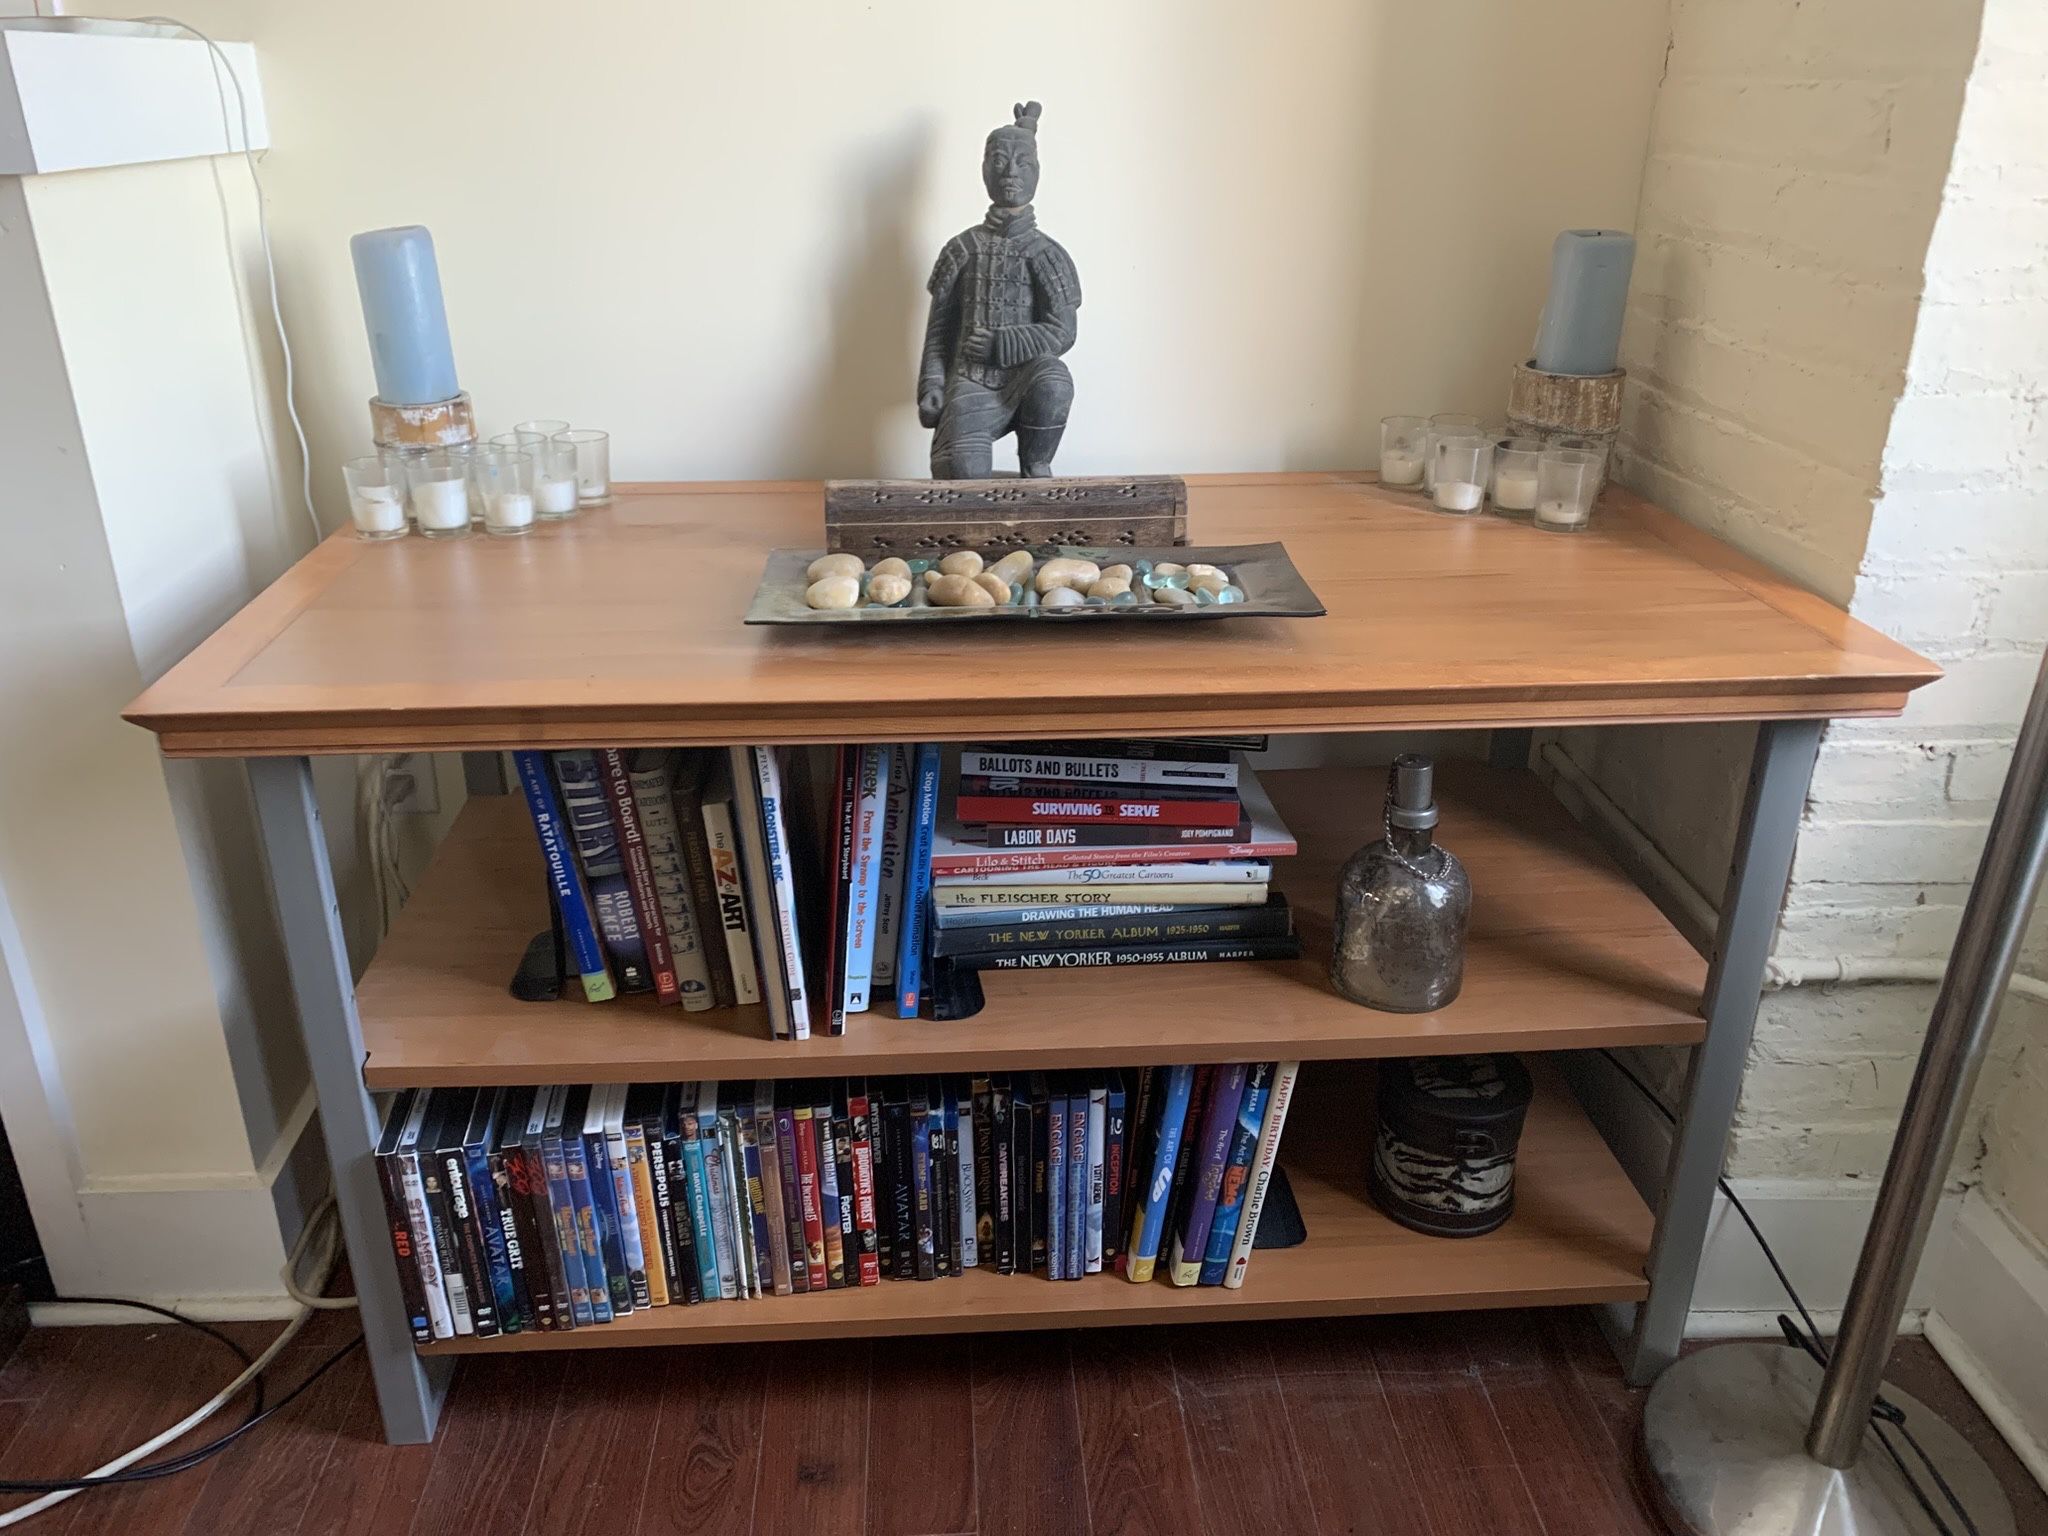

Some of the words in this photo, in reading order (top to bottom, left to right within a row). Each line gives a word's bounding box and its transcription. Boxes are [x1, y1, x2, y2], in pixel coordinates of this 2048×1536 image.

[524, 758, 536, 775] THE
[761, 755, 770, 784] PIXAR
[979, 757, 1032, 773] BALLOTS
[1035, 763, 1061, 775] AND
[1065, 763, 1119, 778] BULLETS
[529, 779, 541, 795] ART
[615, 780, 627, 795] to
[922, 771, 935, 792] Stop
[534, 798, 545, 810] OF
[556, 759, 623, 869] STORY
[844, 801, 852, 812] The
[921, 793, 932, 825] Motion
[1032, 802, 1102, 817] SURVIVING
[1119, 804, 1160, 818] SERVE
[619, 797, 640, 843] Board!
[862, 810, 874, 834] From
[715, 832, 725, 848] the
[843, 835, 851, 845] the
[882, 784, 907, 879] Animation
[920, 826, 929, 847] Craft
[1005, 830, 1041, 845] LABOR
[1047, 829, 1076, 844] DAYS
[1181, 829, 1194, 838] JOEY
[538, 813, 571, 897] RATATOUILLE
[861, 837, 873, 851] the
[1228, 845, 1254, 855] Disney
[841, 847, 850, 880] Storyboard
[916, 848, 928, 870] Skills
[976, 857, 999, 867] Lilo
[1012, 854, 1045, 865] Stitch
[1063, 853, 1091, 861] Collected
[1093, 852, 1115, 860] Stories
[1116, 852, 1131, 861] from
[1143, 851, 1162, 859] Film's
[641, 870, 650, 886] Story
[772, 864, 784, 885] INC.
[858, 855, 870, 886] Swamp
[916, 872, 926, 884] for
[1068, 871, 1083, 879] The
[1082, 870, 1101, 883] 50
[1101, 871, 1135, 879] Greatest
[1139, 871, 1174, 879] Cartoons
[724, 884, 733, 893] of
[859, 889, 868, 898] to
[956, 895, 975, 903] the
[981, 894, 1059, 903] FLEISCHER
[1065, 894, 1111, 903] STORY
[640, 900, 648, 911] and
[857, 902, 867, 916] the
[881, 893, 892, 916] Jeffrey
[913, 886, 924, 914] Model
[596, 894, 622, 941] McKEE
[614, 891, 639, 940] ROBERT
[721, 893, 746, 933] ART
[1022, 909, 1075, 921] DRAWING
[1078, 908, 1097, 918] THE
[1101, 905, 1140, 915] HUMAN
[1145, 905, 1174, 913] HEAD
[781, 910, 794, 950] ESSENTIAL
[854, 919, 864, 949] Screen
[882, 918, 890, 934] Scott
[910, 914, 922, 956] Animation
[989, 933, 1014, 943] THE
[1020, 931, 1049, 941] NEW
[1056, 928, 1105, 940] YORKER
[1112, 926, 1159, 938] ALBUM
[1167, 925, 1209, 935] 1925-1950
[786, 952, 797, 977] GUIDE
[995, 959, 1017, 967] THE
[1021, 954, 1055, 968] NEW
[1055, 952, 1112, 966] YORKER
[1117, 952, 1164, 962] 1950-1955
[1167, 951, 1208, 961] ALBUM
[1251, 1064, 1267, 1088] Disney
[1092, 1096, 1104, 1105] Y
[1248, 1088, 1261, 1112] PIXAR
[1274, 1075, 1291, 1112] HAPPY
[871, 1103, 880, 1137] MYSTIC
[1050, 1114, 1062, 1163] ENGAGE
[1072, 1111, 1085, 1161] ENGAGE
[1169, 1127, 1177, 1138] THE
[1218, 1129, 1228, 1141] The
[1241, 1132, 1251, 1144] The
[823, 1141, 835, 1162] IRON
[873, 1138, 882, 1164] RIVER
[1166, 1140, 1176, 1152] ART
[1213, 1142, 1224, 1153] Art
[1237, 1145, 1248, 1156] Art
[1110, 1144, 1120, 1195] INCEPTION
[1163, 1154, 1173, 1164] OF
[1236, 1156, 1245, 1164] of
[651, 1142, 670, 1207] PERSEPOLIS
[704, 1155, 721, 1195] Christmas
[801, 1173, 815, 1184] THE
[825, 1163, 835, 1186] GIANT
[855, 1148, 871, 1194] BROOKLYN'S
[962, 1163, 973, 1189] BLACK
[999, 1142, 1009, 1222] DAYBREAKERS
[1093, 1169, 1102, 1181] CITY
[446, 1158, 469, 1219] entourage
[693, 1173, 702, 1193] DAVE
[1093, 1182, 1102, 1204] AGENDA
[1152, 1167, 1172, 1203] UP
[1223, 1166, 1246, 1207] NEMO
[1250, 1171, 1269, 1210] Charlie
[802, 1185, 817, 1221] INCREDIBLES
[859, 1195, 873, 1223] FINEST
[919, 1189, 928, 1210] YARD
[962, 1189, 974, 1214] SWAN
[500, 1208, 517, 1239] TRUE
[840, 1195, 852, 1234] FIGHTER
[895, 1184, 910, 1242] AVATAR
[463, 1223, 471, 1234] THE
[1241, 1211, 1260, 1246] Brown
[395, 1231, 411, 1257] RED
[408, 1199, 438, 1288] STEAMBOY
[506, 1240, 523, 1269] GRIT
[485, 1227, 509, 1289] AVATAR
